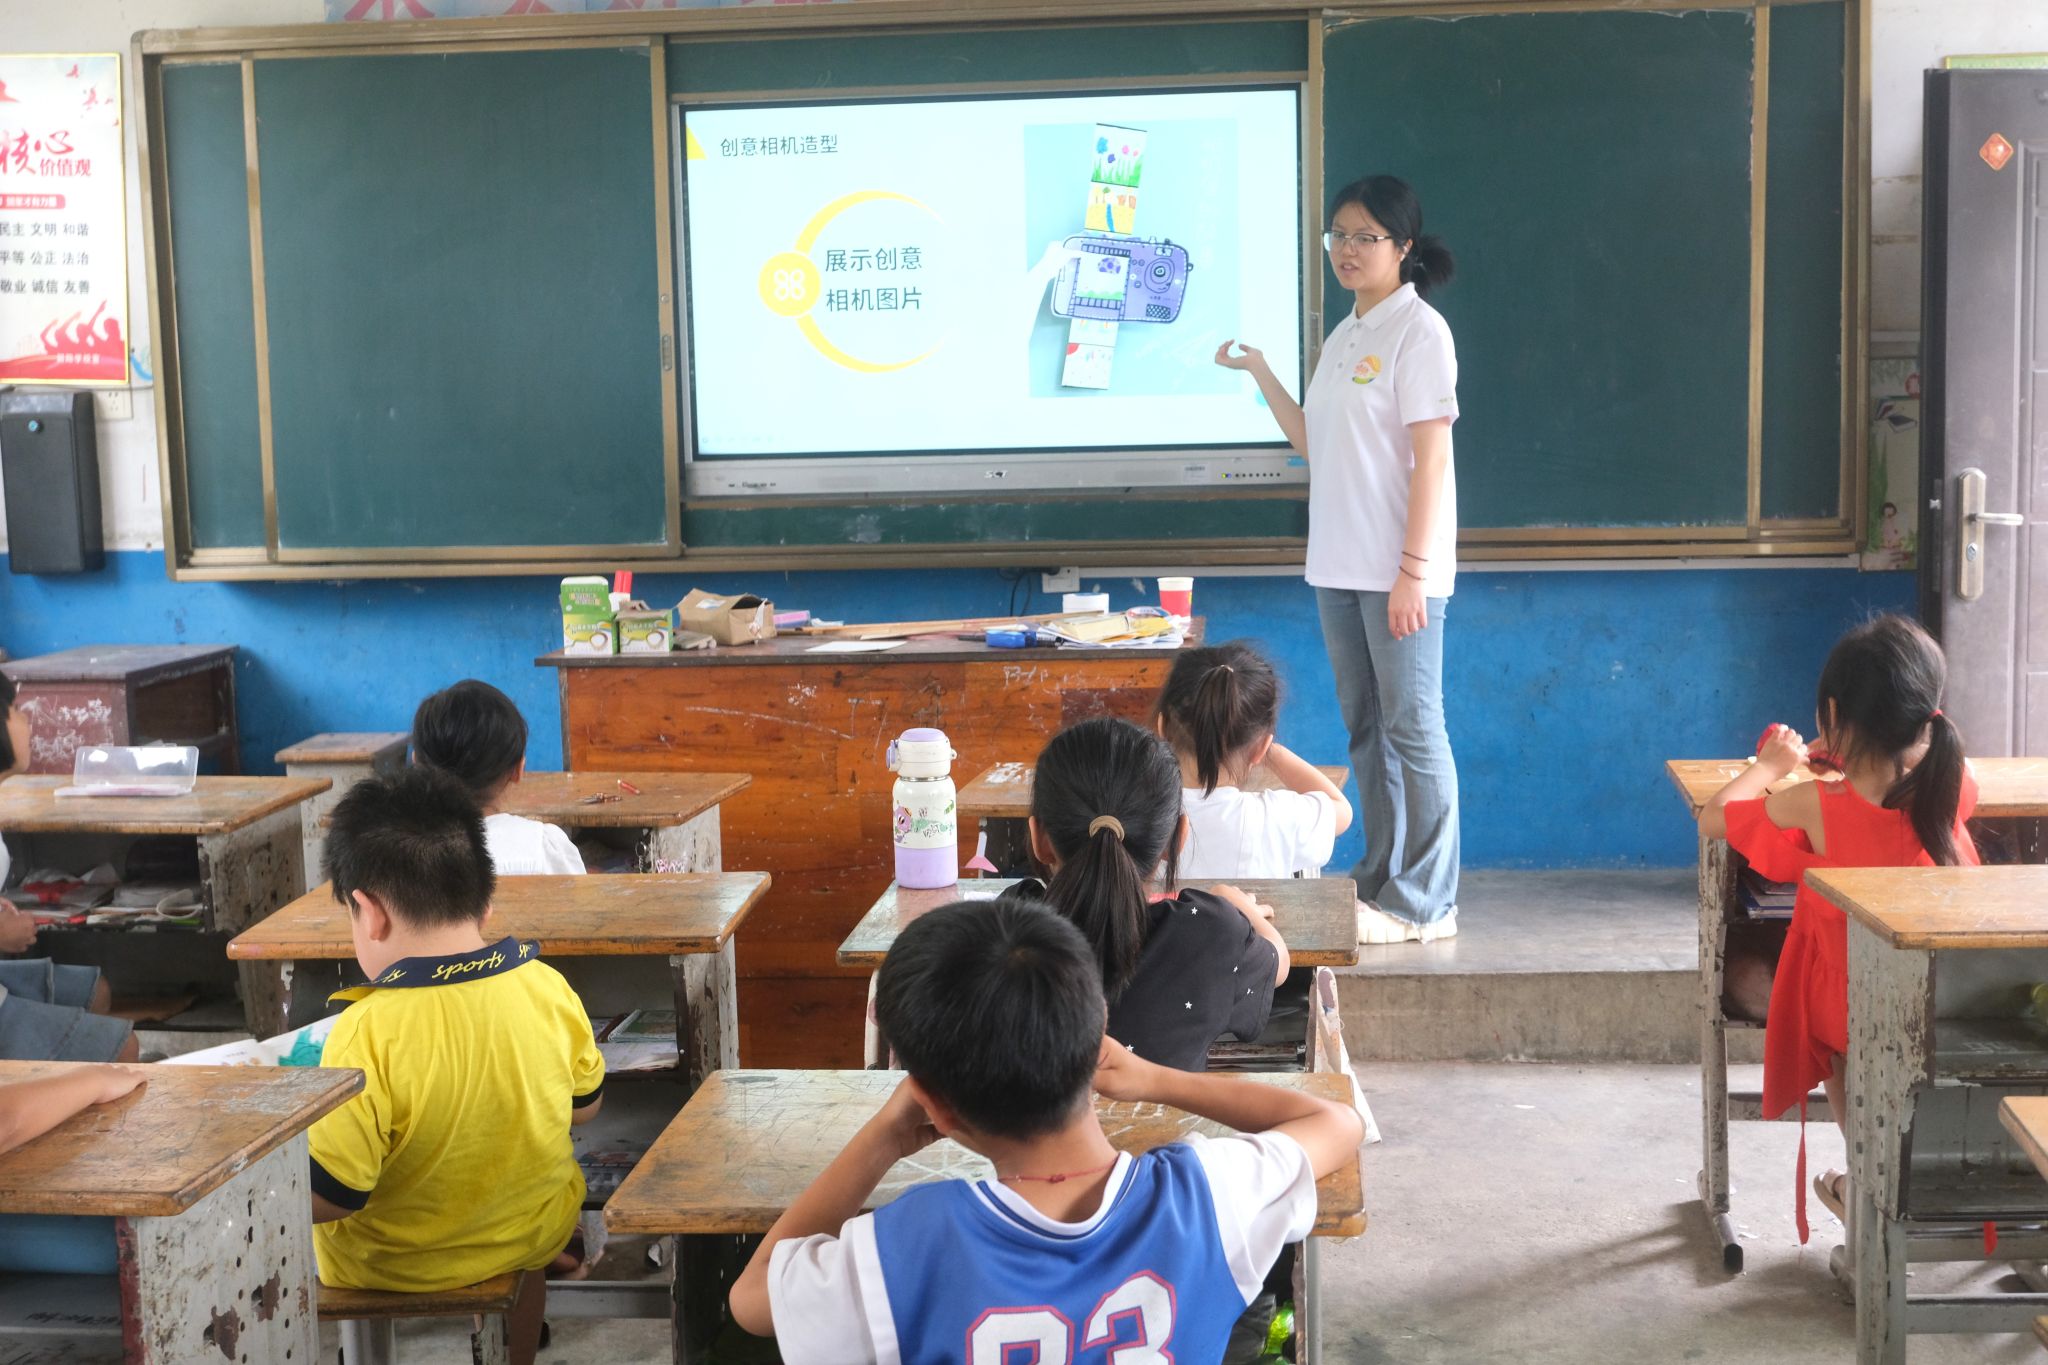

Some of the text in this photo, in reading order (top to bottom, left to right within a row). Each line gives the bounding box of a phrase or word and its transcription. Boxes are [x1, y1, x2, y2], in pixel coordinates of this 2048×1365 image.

[0, 128, 74, 175] 核心
[720, 134, 839, 157] 创意相机造型
[40, 158, 91, 176] 价值观
[0, 222, 88, 236] 民主 文明 和谐
[0, 250, 88, 265] 平等 公正 法治
[825, 246, 922, 272] 展示创意
[0, 279, 89, 294] 敬业 诚信 友善
[826, 286, 922, 312] 相机图片
[431, 950, 506, 980] sports
